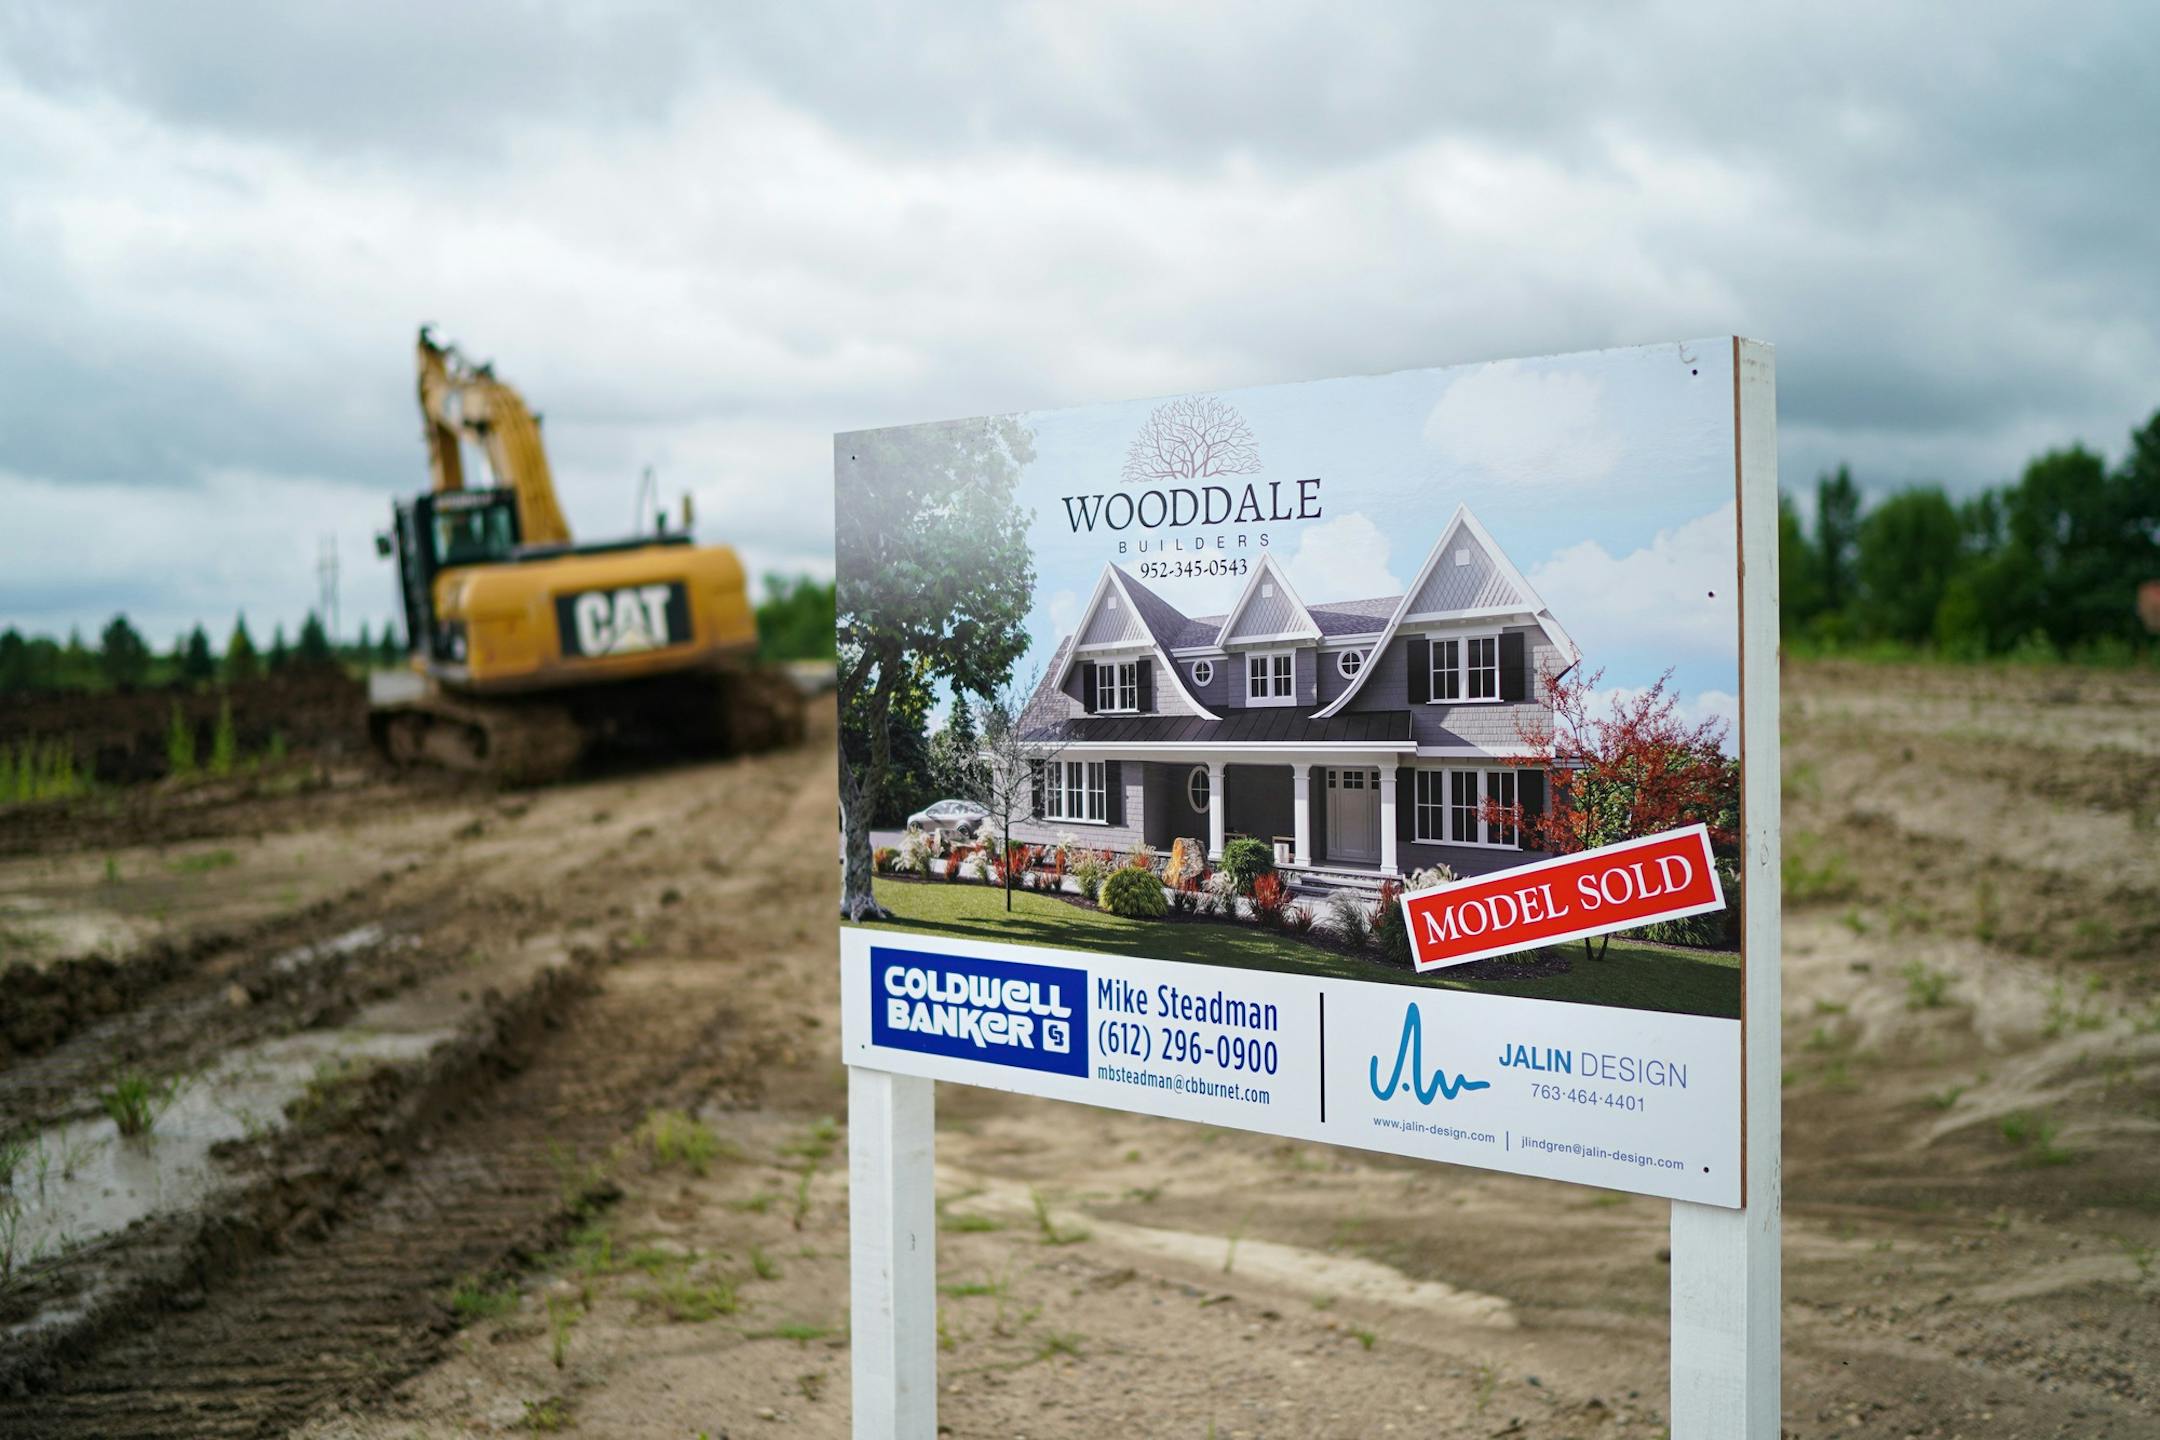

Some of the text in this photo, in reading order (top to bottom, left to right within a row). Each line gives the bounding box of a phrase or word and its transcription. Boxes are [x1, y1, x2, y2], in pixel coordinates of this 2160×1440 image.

[1062, 478, 1323, 533] WOODDALE
[1119, 533, 1269, 553] BUILDERS
[1140, 558, 1248, 579] 952-345-0543
[573, 583, 672, 658] CAT
[1421, 854, 1693, 945] MODEL SOLD
[1098, 977, 1277, 1031] Mike Steadman
[1098, 1020, 1277, 1075] (612) 296-0900
[1499, 1043, 1688, 1089] JALIN DESIGN
[1098, 1064, 1270, 1104] mbsteadman@cbburnet.com
[1373, 1117, 1685, 1170] www.jalin-design.com jlindgren@jalin-design.com
